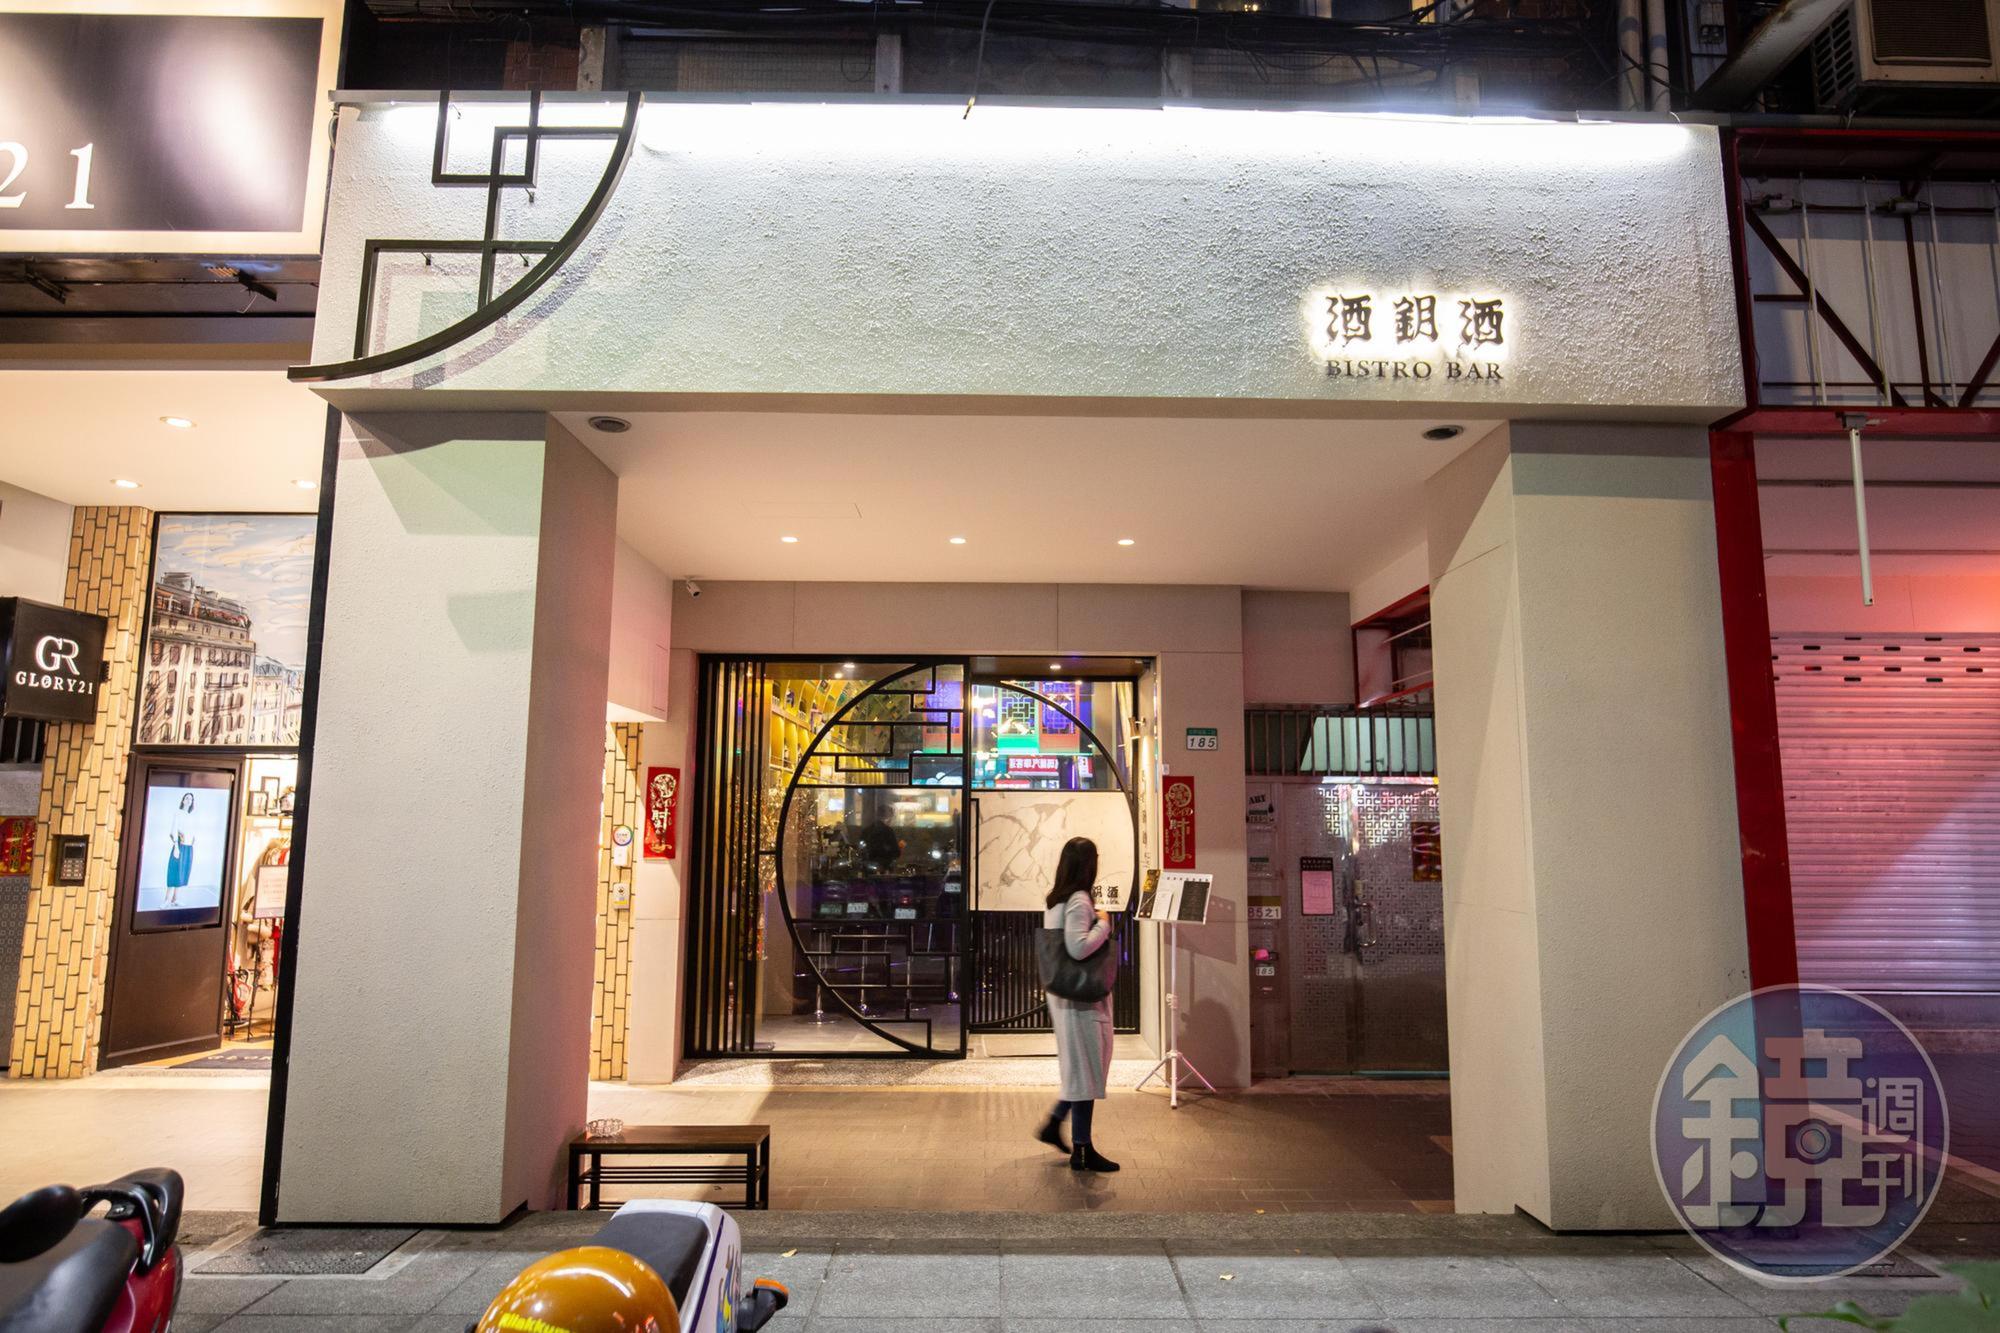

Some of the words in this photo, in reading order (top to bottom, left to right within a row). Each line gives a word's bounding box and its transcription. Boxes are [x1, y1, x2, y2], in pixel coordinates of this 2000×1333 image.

[1326, 359, 1433, 379] BISTRO
[1446, 361, 1504, 380] BAR
[15, 670, 94, 695] GLORY21
[1189, 737, 1216, 748] 185
